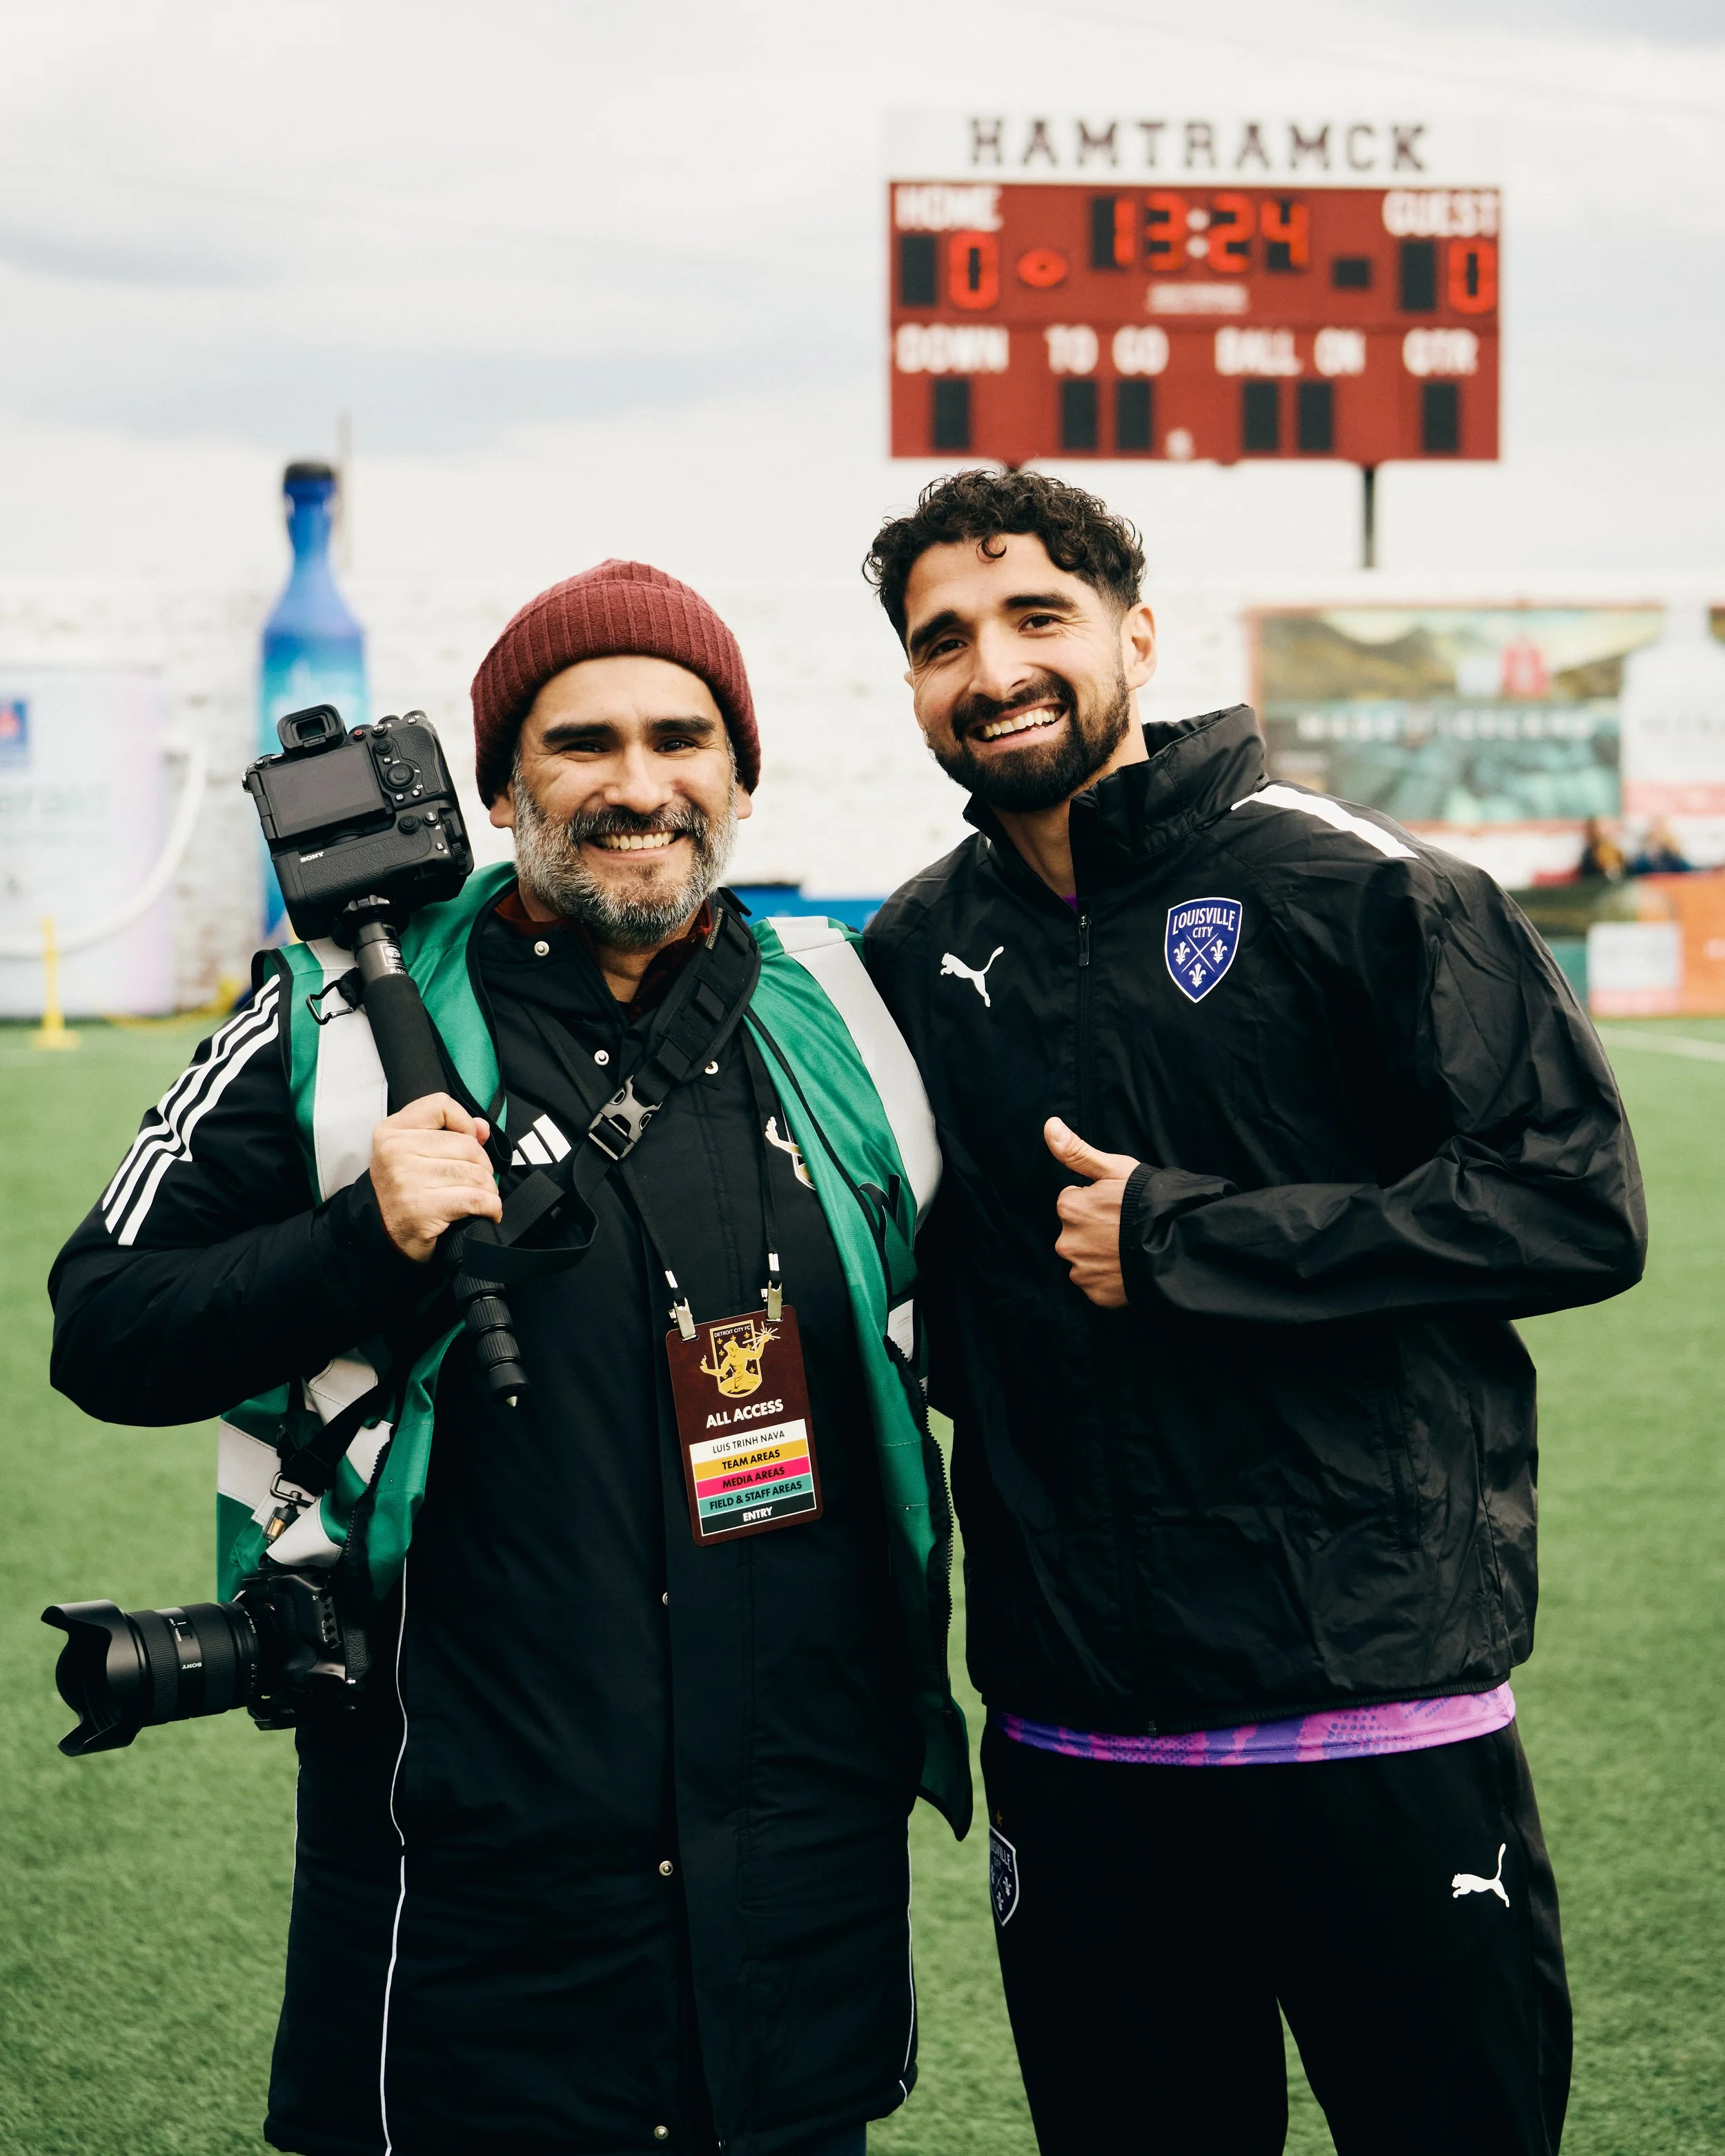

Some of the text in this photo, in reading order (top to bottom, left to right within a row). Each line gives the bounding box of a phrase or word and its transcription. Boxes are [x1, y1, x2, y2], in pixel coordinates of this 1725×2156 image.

[970, 119, 1426, 171] HAMTRAMCK
[896, 186, 1003, 232] HOME
[1383, 190, 1499, 237] GUEST
[1112, 192, 1310, 273] 13:24
[949, 230, 1000, 310] 0
[1450, 239, 1498, 315] 0
[896, 323, 1010, 375] DOWN
[1044, 324, 1170, 376] TO GO
[1214, 326, 1367, 377] BALL ON
[1403, 327, 1479, 377] QTR
[300, 851, 324, 862] SONY
[1172, 907, 1236, 936] LOUISVILLE
[1192, 926, 1214, 938] CITY
[713, 1329, 733, 1338] DETROIT
[706, 1398, 784, 1429] ALL ACCESS
[712, 1430, 785, 1454] LUIS TRINH NAVA
[722, 1449, 780, 1470] TEAM AREAS
[709, 1481, 802, 1510] FIELD & STAFF AREAS
[722, 1467, 785, 1489] MEDIA AREAS
[742, 1506, 773, 1522] ENTRY
